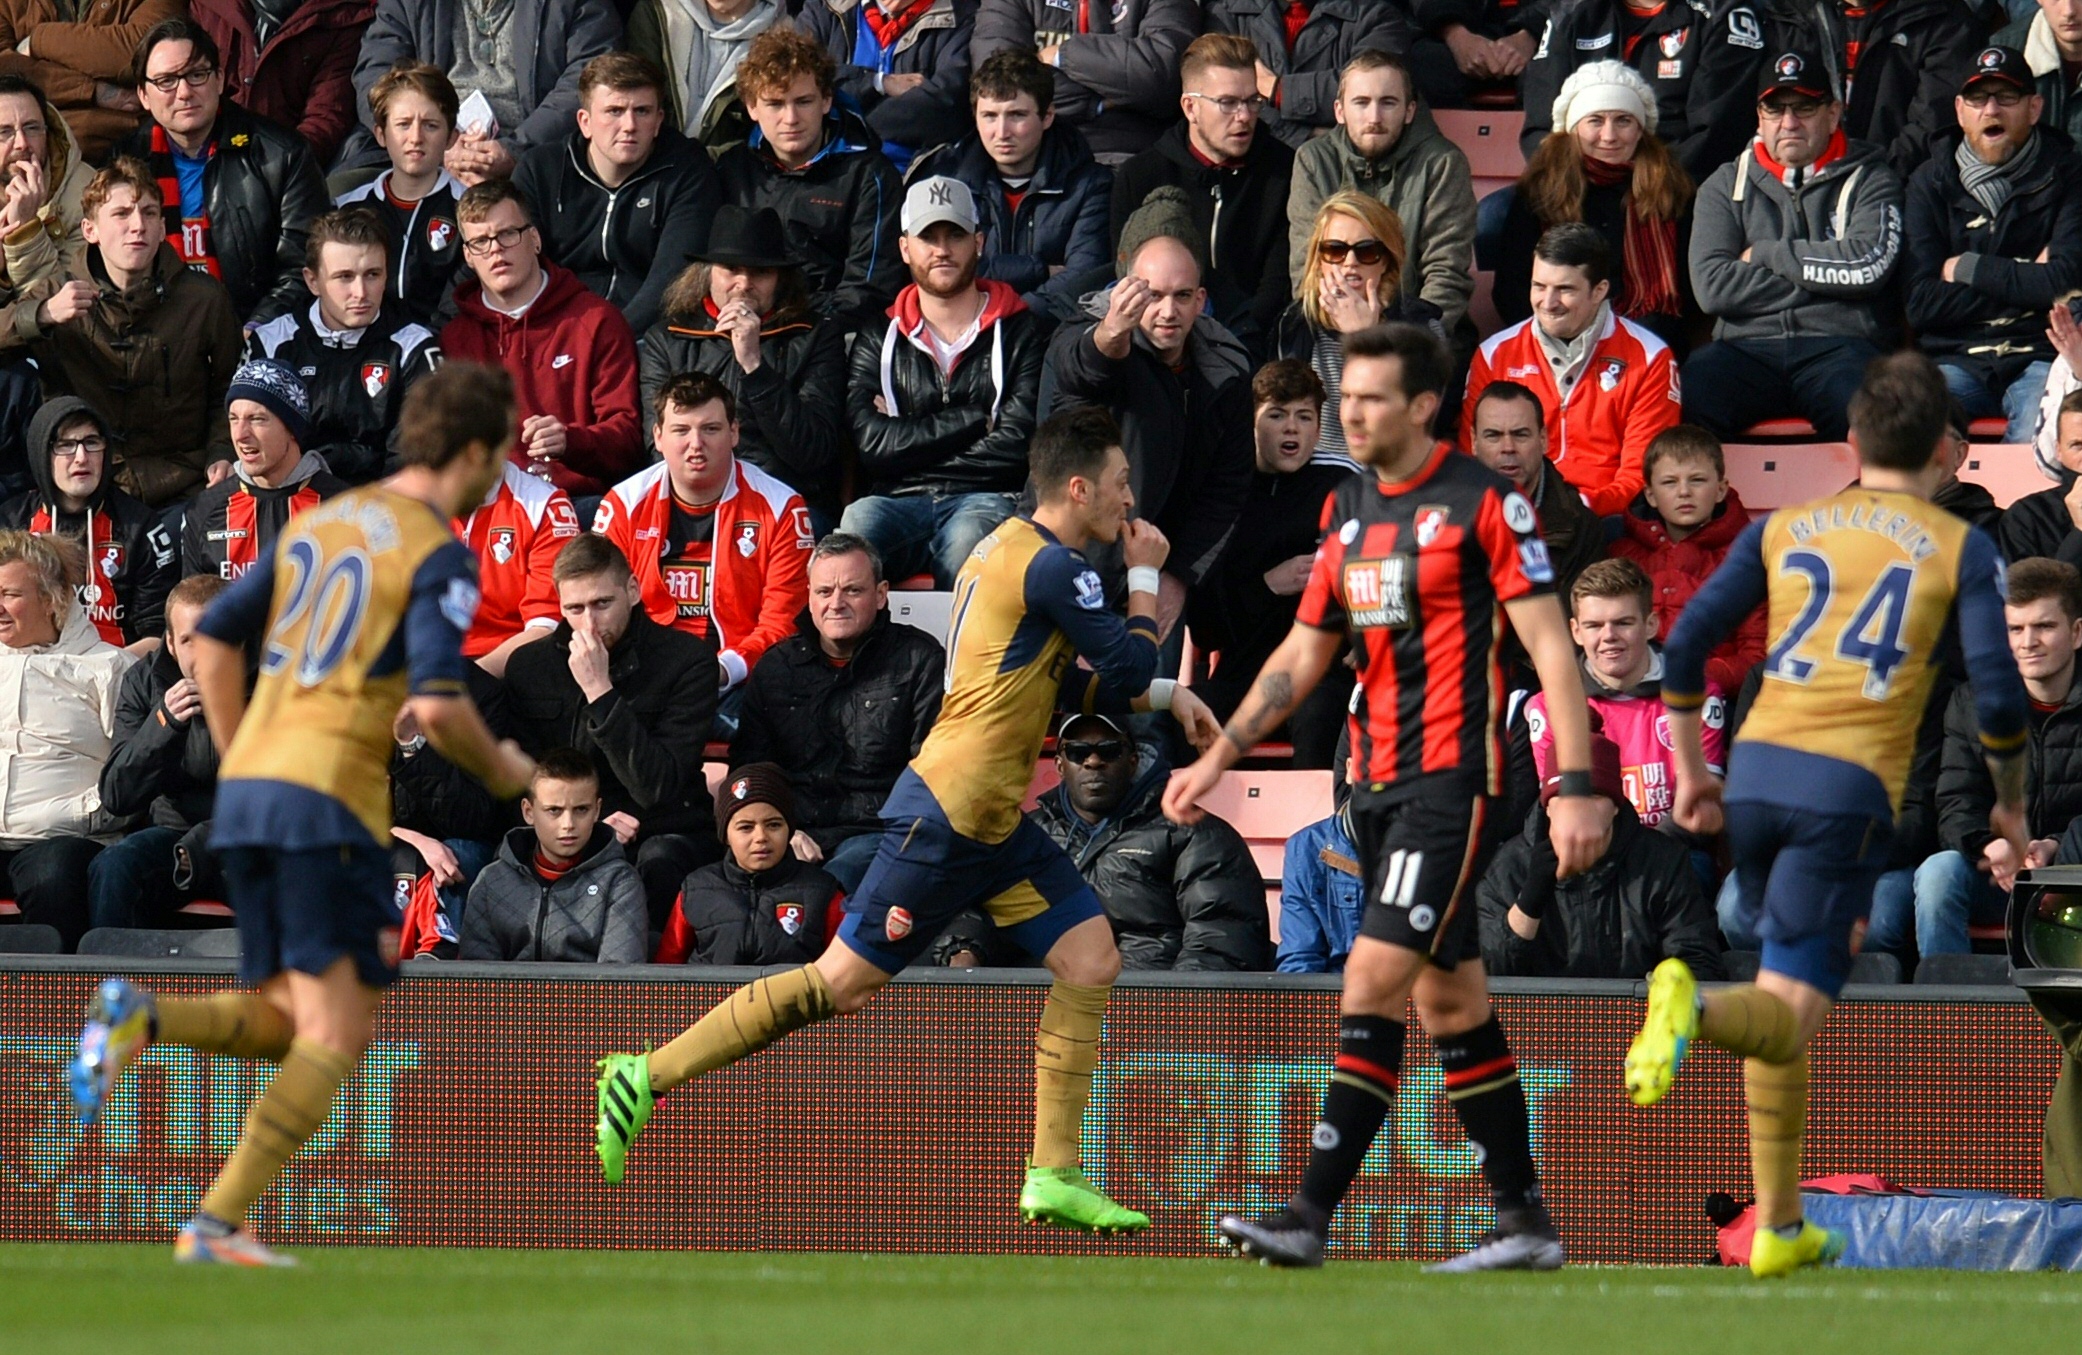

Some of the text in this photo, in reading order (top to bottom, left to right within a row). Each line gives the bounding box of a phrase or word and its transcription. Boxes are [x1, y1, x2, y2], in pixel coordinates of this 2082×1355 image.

[1803, 231, 1900, 285] BOURNEMOUTH
[1787, 503, 1937, 564] BELLERIN
[259, 530, 374, 688] 20
[1763, 545, 1917, 703] 24
[1707, 704, 1722, 720] JD
[1380, 848, 1425, 908] 11
